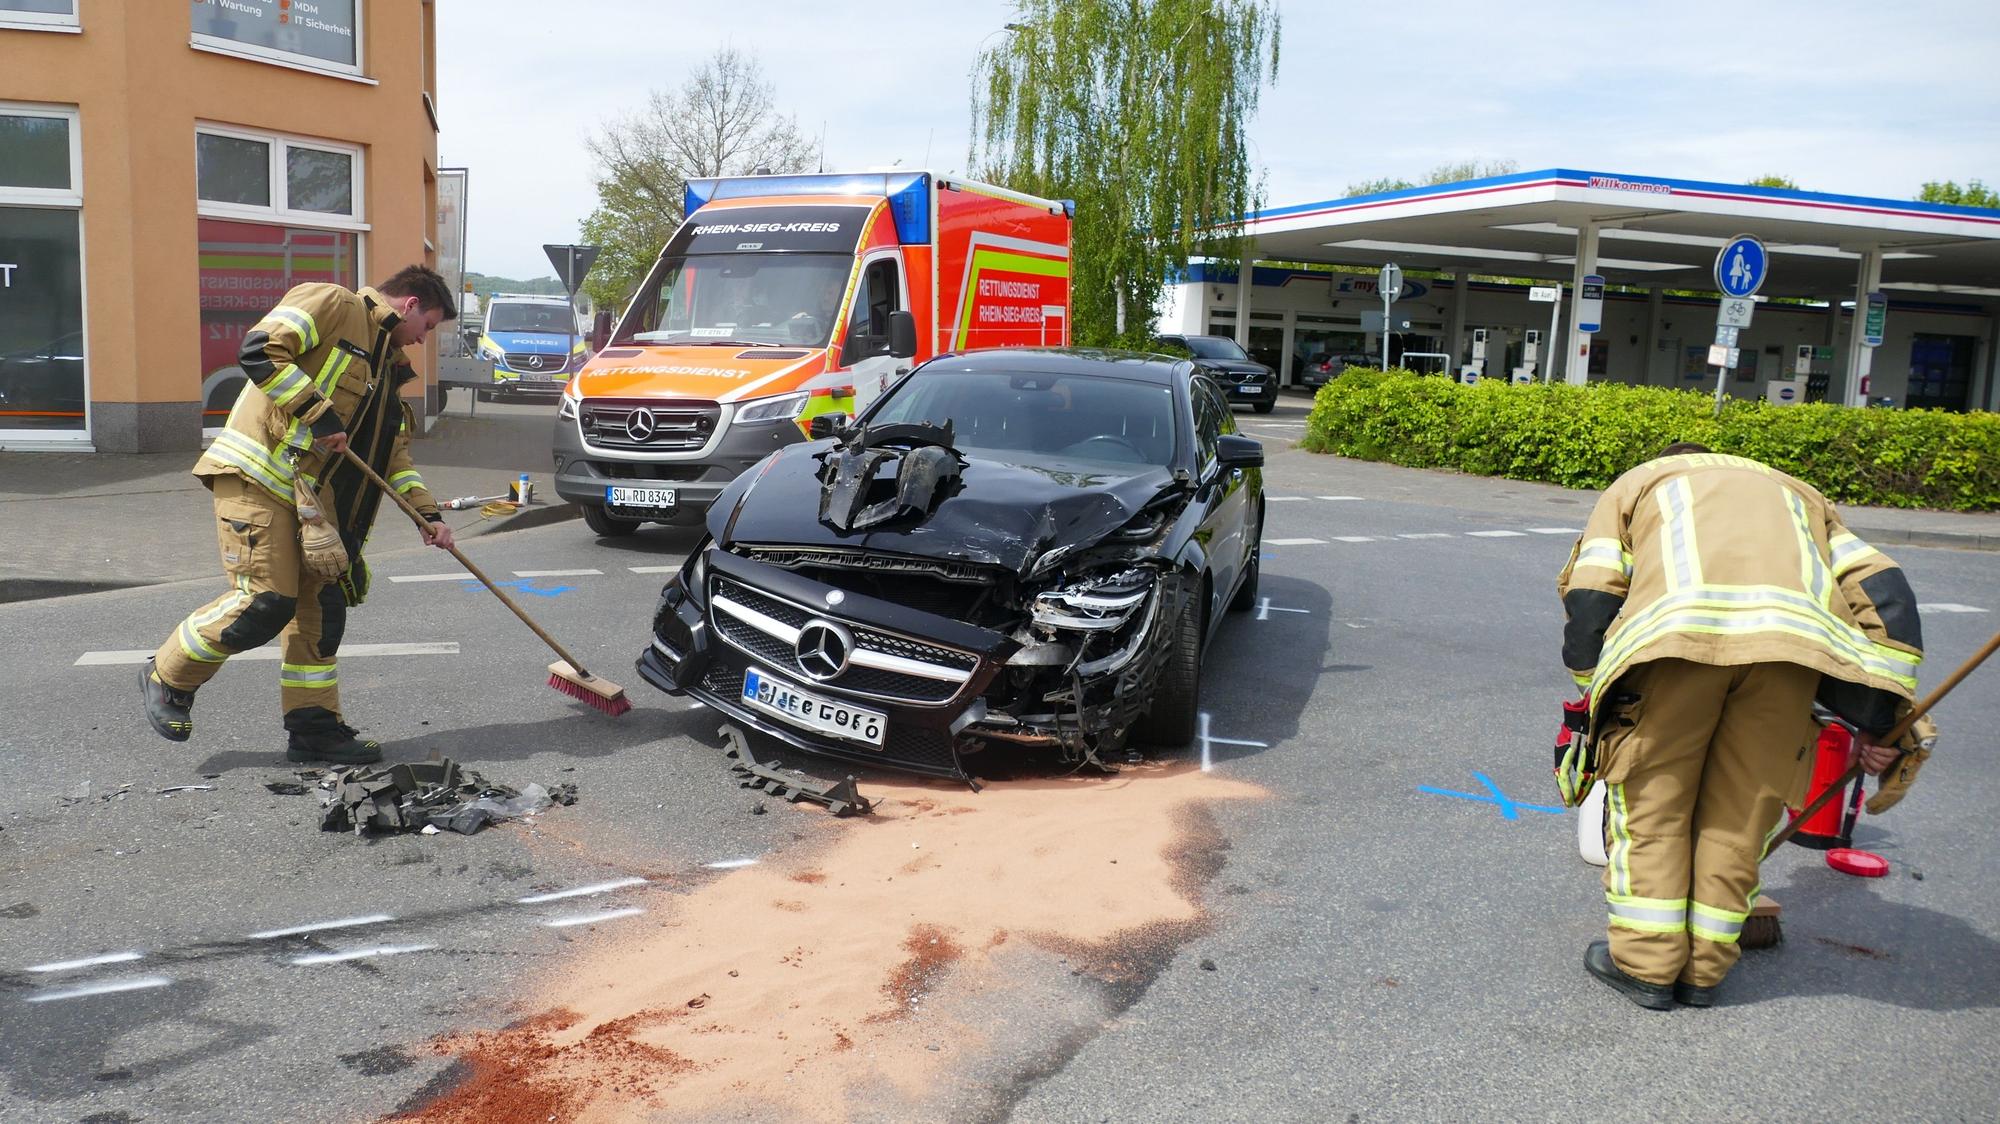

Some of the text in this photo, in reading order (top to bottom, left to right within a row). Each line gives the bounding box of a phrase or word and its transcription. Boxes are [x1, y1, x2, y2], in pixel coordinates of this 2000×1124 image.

[219, 0, 262, 17] Wartung
[294, 1, 319, 15] MDM
[295, 15, 351, 36] IT Sicherheit
[1590, 177, 1670, 193] Willkommen
[691, 222, 840, 236] RHEIN-SIEG-KREIS
[979, 279, 1040, 299] RETTUNGSDIENST
[1354, 281, 1375, 293] my
[979, 305, 1041, 322] RHEIN-SIEG-KREIS
[588, 365, 751, 379] RETTUNGSDIENST
[613, 489, 674, 504] SU RD 8342
